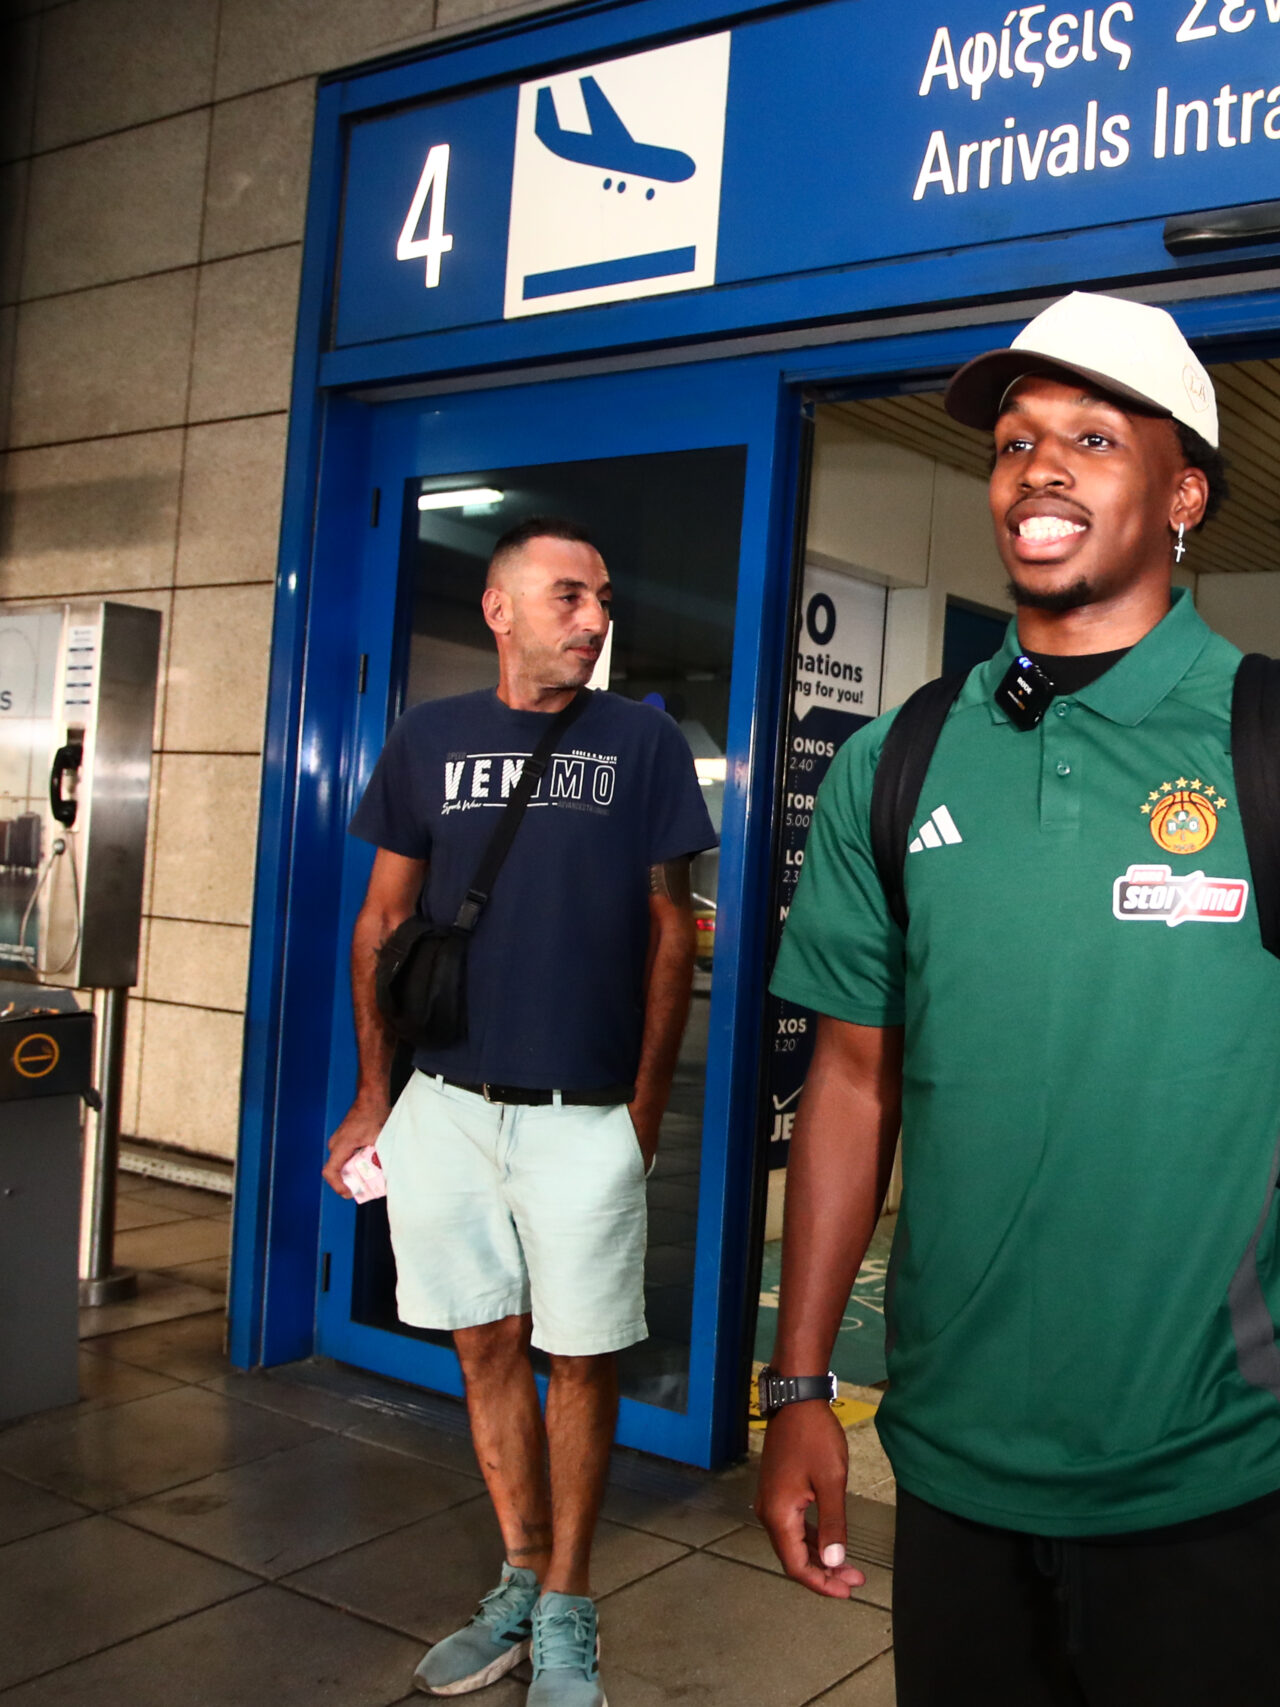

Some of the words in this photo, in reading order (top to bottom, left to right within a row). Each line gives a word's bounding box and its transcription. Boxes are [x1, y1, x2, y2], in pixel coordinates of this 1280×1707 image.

[918, 1, 1134, 101] Αφίξεις
[912, 100, 1130, 201] Arrivals
[396, 143, 453, 289] 4
[816, 681, 834, 698] for
[837, 688, 864, 704] you!
